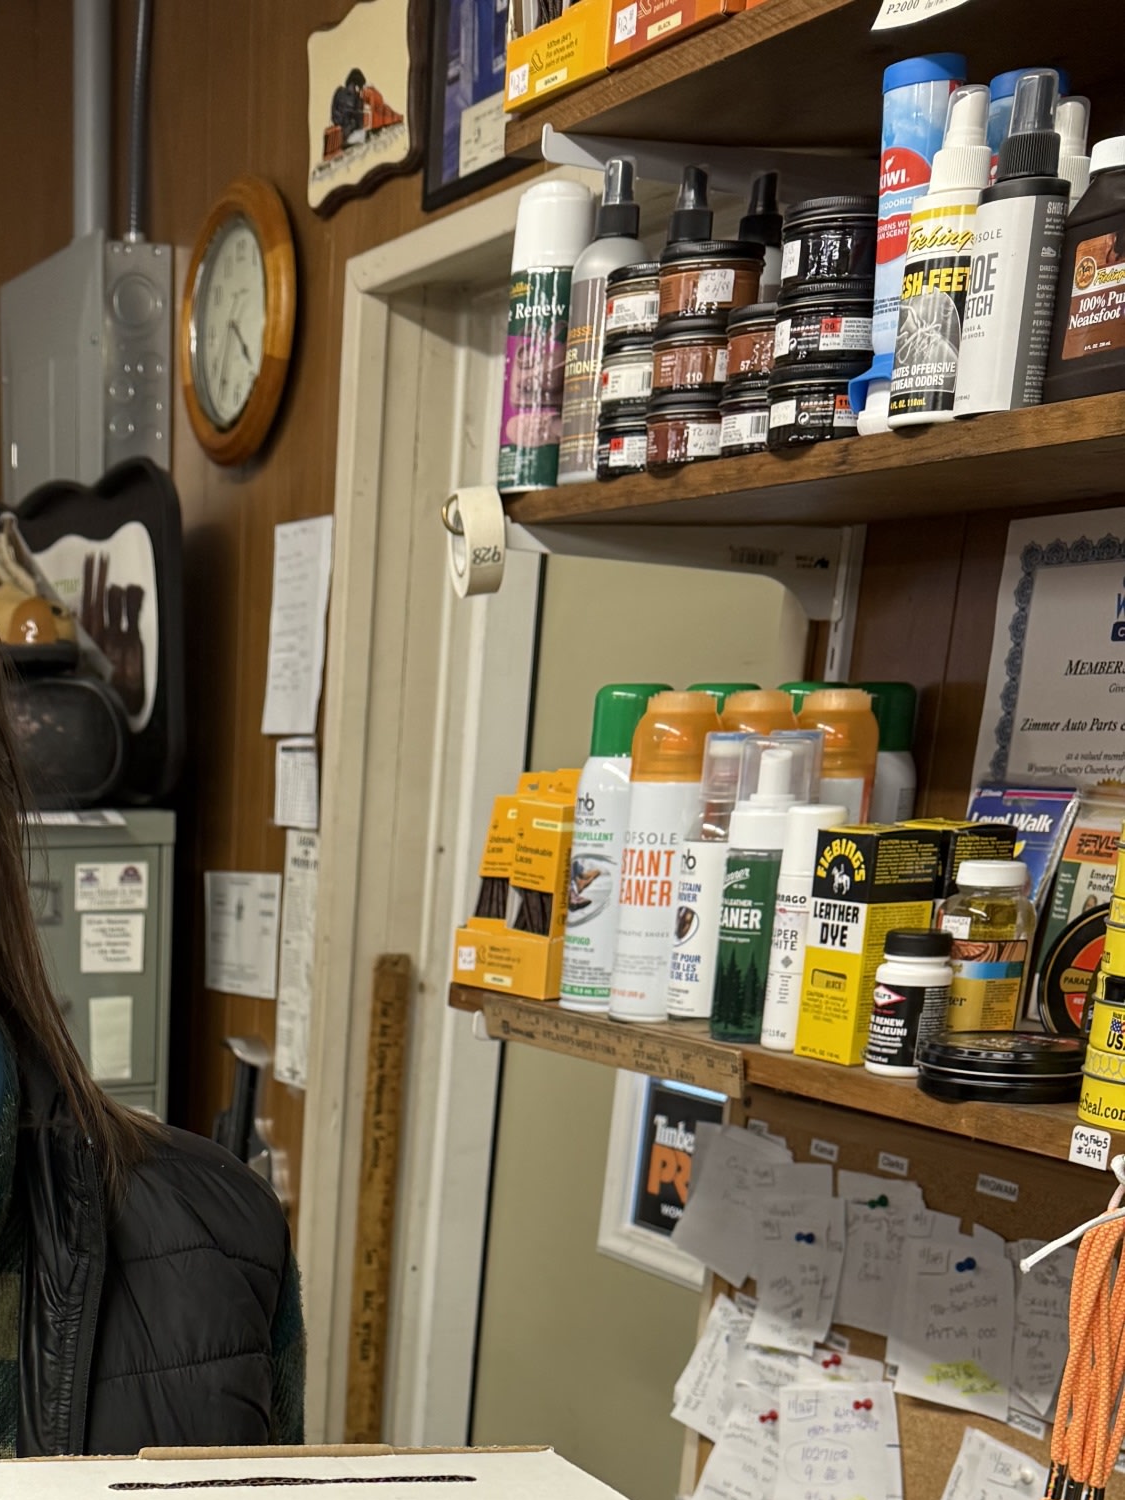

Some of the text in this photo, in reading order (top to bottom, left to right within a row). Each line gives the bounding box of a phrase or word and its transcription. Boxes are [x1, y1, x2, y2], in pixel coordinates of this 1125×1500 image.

[515, 302, 566, 319] Renew
[1079, 293, 1106, 313] 100%
[1068, 306, 1120, 330] Neatsfoot
[686, 372, 703, 382] 110
[911, 362, 956, 375] OFFENSIVE
[915, 375, 944, 387] ODORS
[1020, 718, 1118, 732] Zimmer Auto Parts
[1084, 763, 1115, 774] Chamber
[1013, 813, 1054, 833] Walk
[816, 838, 866, 883] FIEBING'S
[813, 901, 859, 923] LEATHER
[819, 922, 848, 948] DYE
[875, 1016, 905, 1027] RENEW
[647, 1144, 692, 1203] PR
[979, 1178, 1017, 1196] WIGWAM
